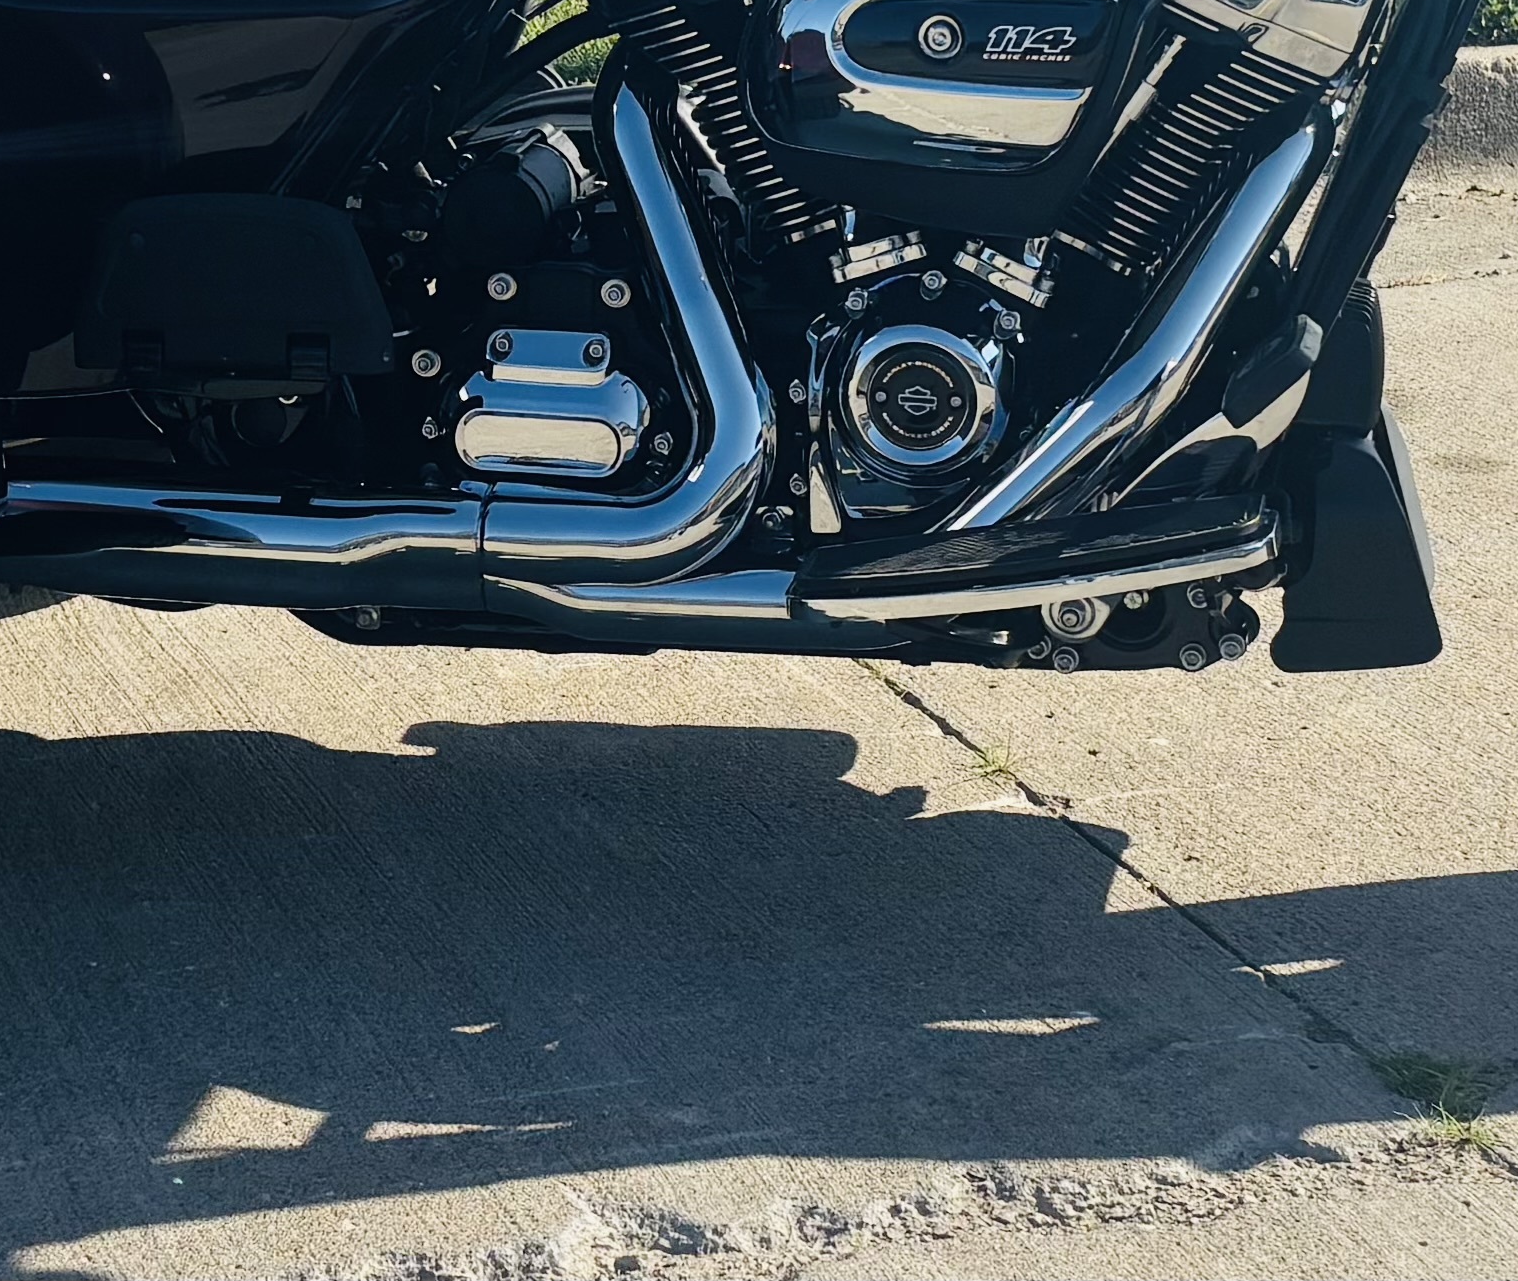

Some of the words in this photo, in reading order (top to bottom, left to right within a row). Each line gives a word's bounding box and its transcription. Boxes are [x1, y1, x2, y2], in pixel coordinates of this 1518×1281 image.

[986, 25, 1077, 53] 114
[983, 52, 1020, 61] CUBIC
[1025, 54, 1072, 62] INCHES
